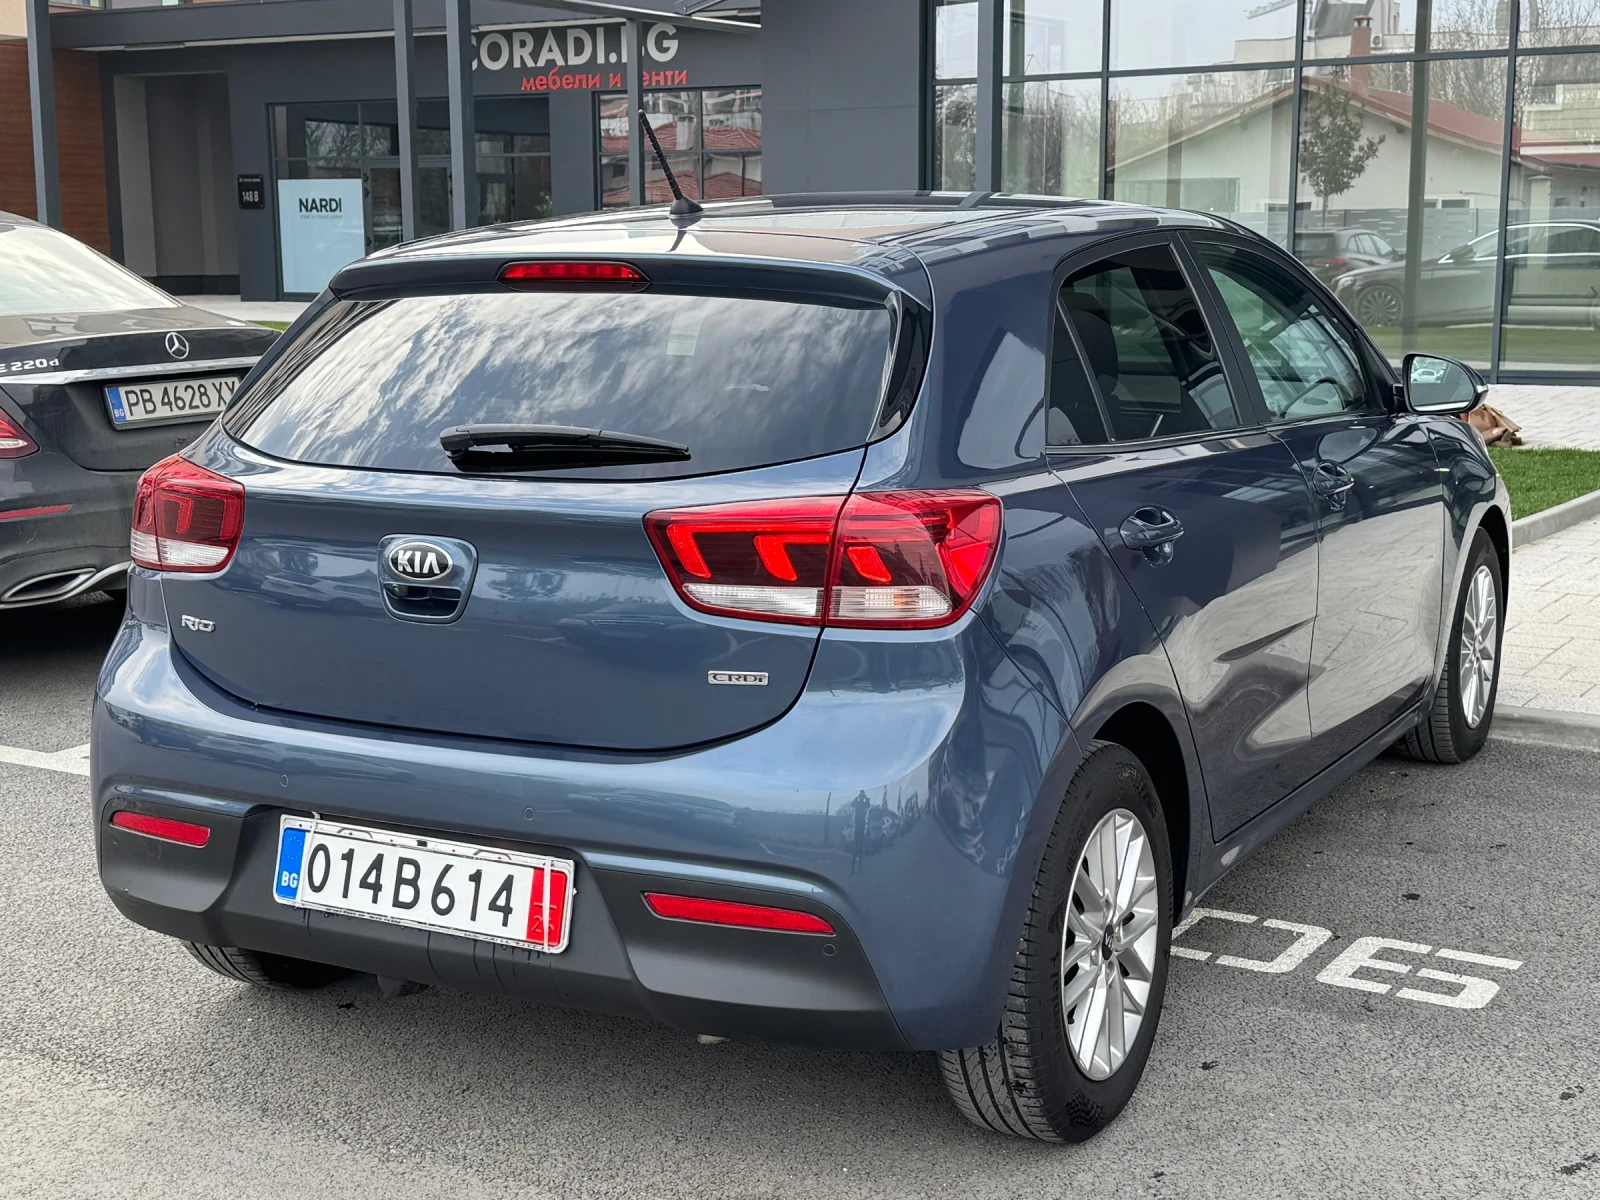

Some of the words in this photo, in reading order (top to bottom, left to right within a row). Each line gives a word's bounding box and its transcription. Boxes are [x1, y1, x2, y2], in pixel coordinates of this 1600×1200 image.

[521, 66, 601, 91] мебели
[609, 72, 622, 88] и
[641, 69, 689, 87] енти
[298, 197, 343, 213] NARDI
[124, 389, 157, 417] PB
[161, 383, 212, 412] 4628
[113, 408, 125, 418] BG
[397, 549, 441, 574] KIA
[181, 614, 216, 632] RIO
[711, 673, 764, 683] CRDi
[281, 870, 299, 888] BG
[307, 843, 515, 928] 014B614
